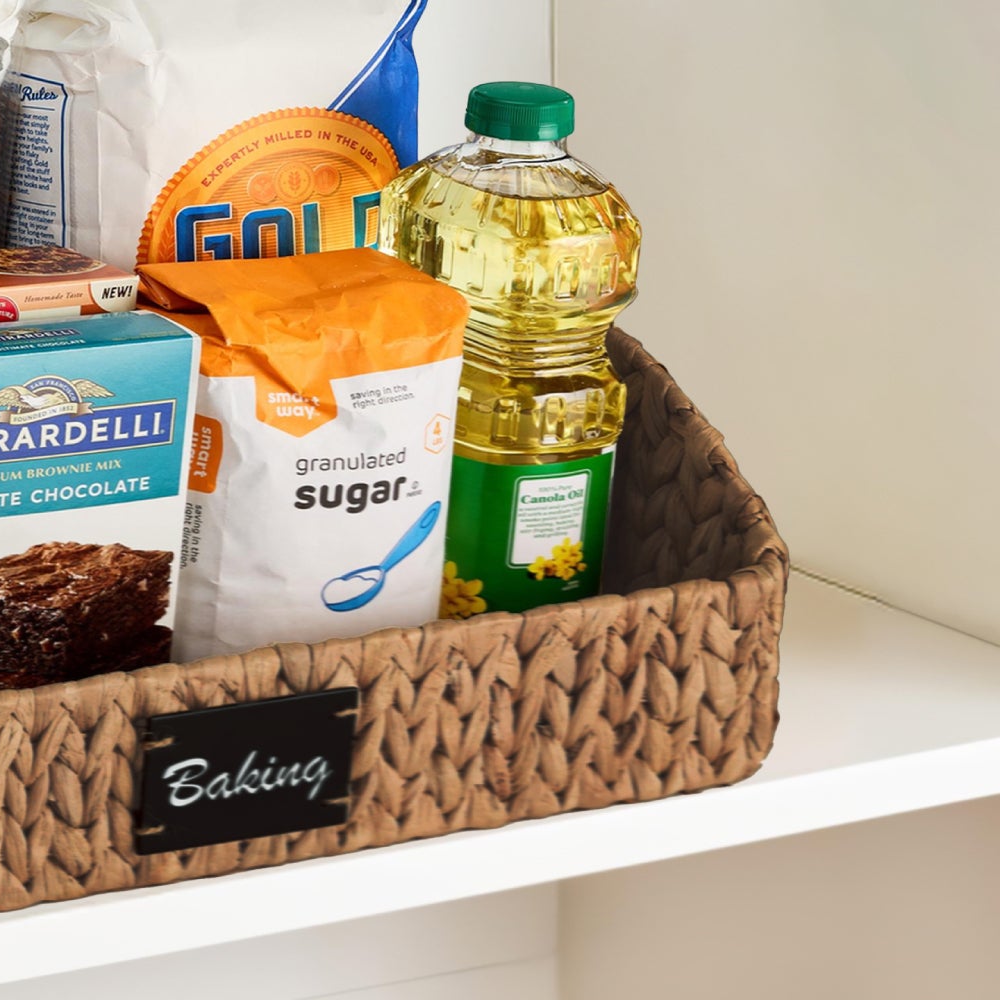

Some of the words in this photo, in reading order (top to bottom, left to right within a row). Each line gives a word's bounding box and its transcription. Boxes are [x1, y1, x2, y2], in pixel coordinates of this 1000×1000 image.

[21, 86, 58, 101] Rules
[201, 140, 260, 187] EXPERTLY
[264, 130, 313, 145] MILLED
[317, 130, 332, 141] IN
[335, 134, 358, 149] THE
[359, 147, 379, 168] USA
[25, 294, 63, 303] Homemade
[65, 291, 83, 299] Taste
[101, 285, 133, 300] NEW!
[36, 338, 86, 348] CHOCOLATE
[350, 389, 381, 400] saving
[393, 384, 408, 393] the
[352, 397, 377, 409] right
[276, 406, 314, 420] way
[193, 426, 212, 477] smart
[27, 463, 92, 478] BROWNIE
[95, 459, 122, 470] MIX
[296, 447, 406, 475] granulated
[30, 476, 150, 503] CHOCOLATE
[294, 476, 407, 514] sugar
[520, 493, 565, 504] Canola
[568, 488, 584, 500] Oil
[192, 505, 203, 534] saving
[192, 537, 202, 546] in
[190, 547, 200, 563] the
[162, 750, 332, 807] Baking
